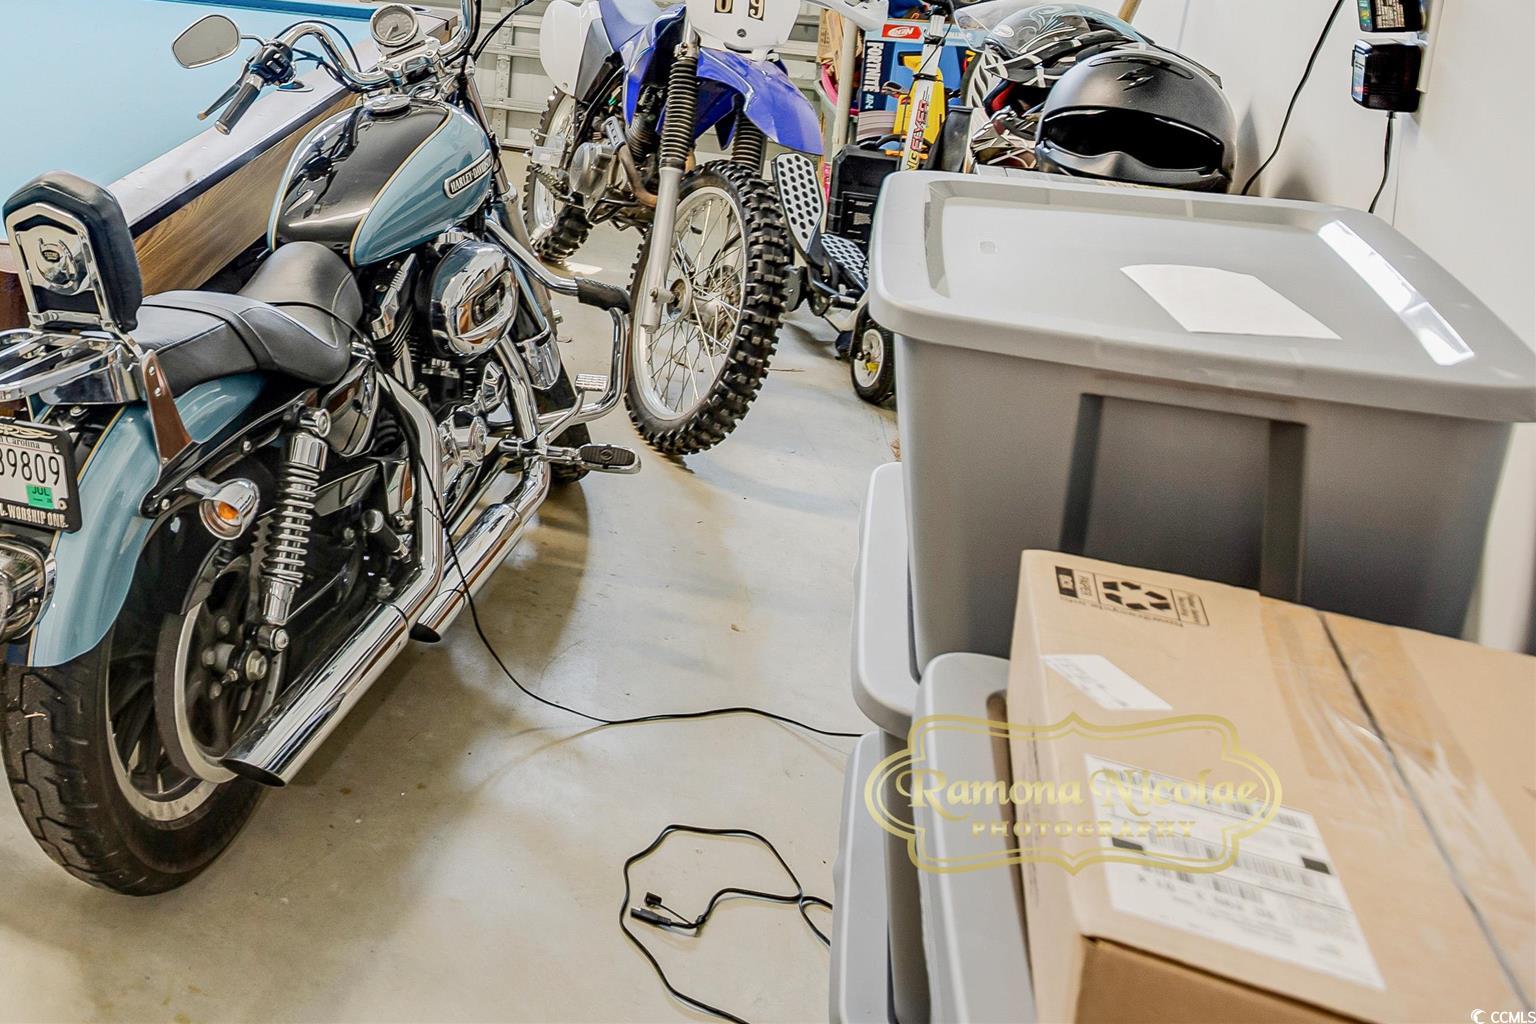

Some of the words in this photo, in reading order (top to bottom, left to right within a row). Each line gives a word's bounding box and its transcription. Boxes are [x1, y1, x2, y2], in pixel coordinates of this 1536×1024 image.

[862, 42, 884, 92] FORTNITE
[6, 435, 40, 449] Carolina
[32, 487, 50, 496] JUL
[8, 504, 46, 524] WORSHIP
